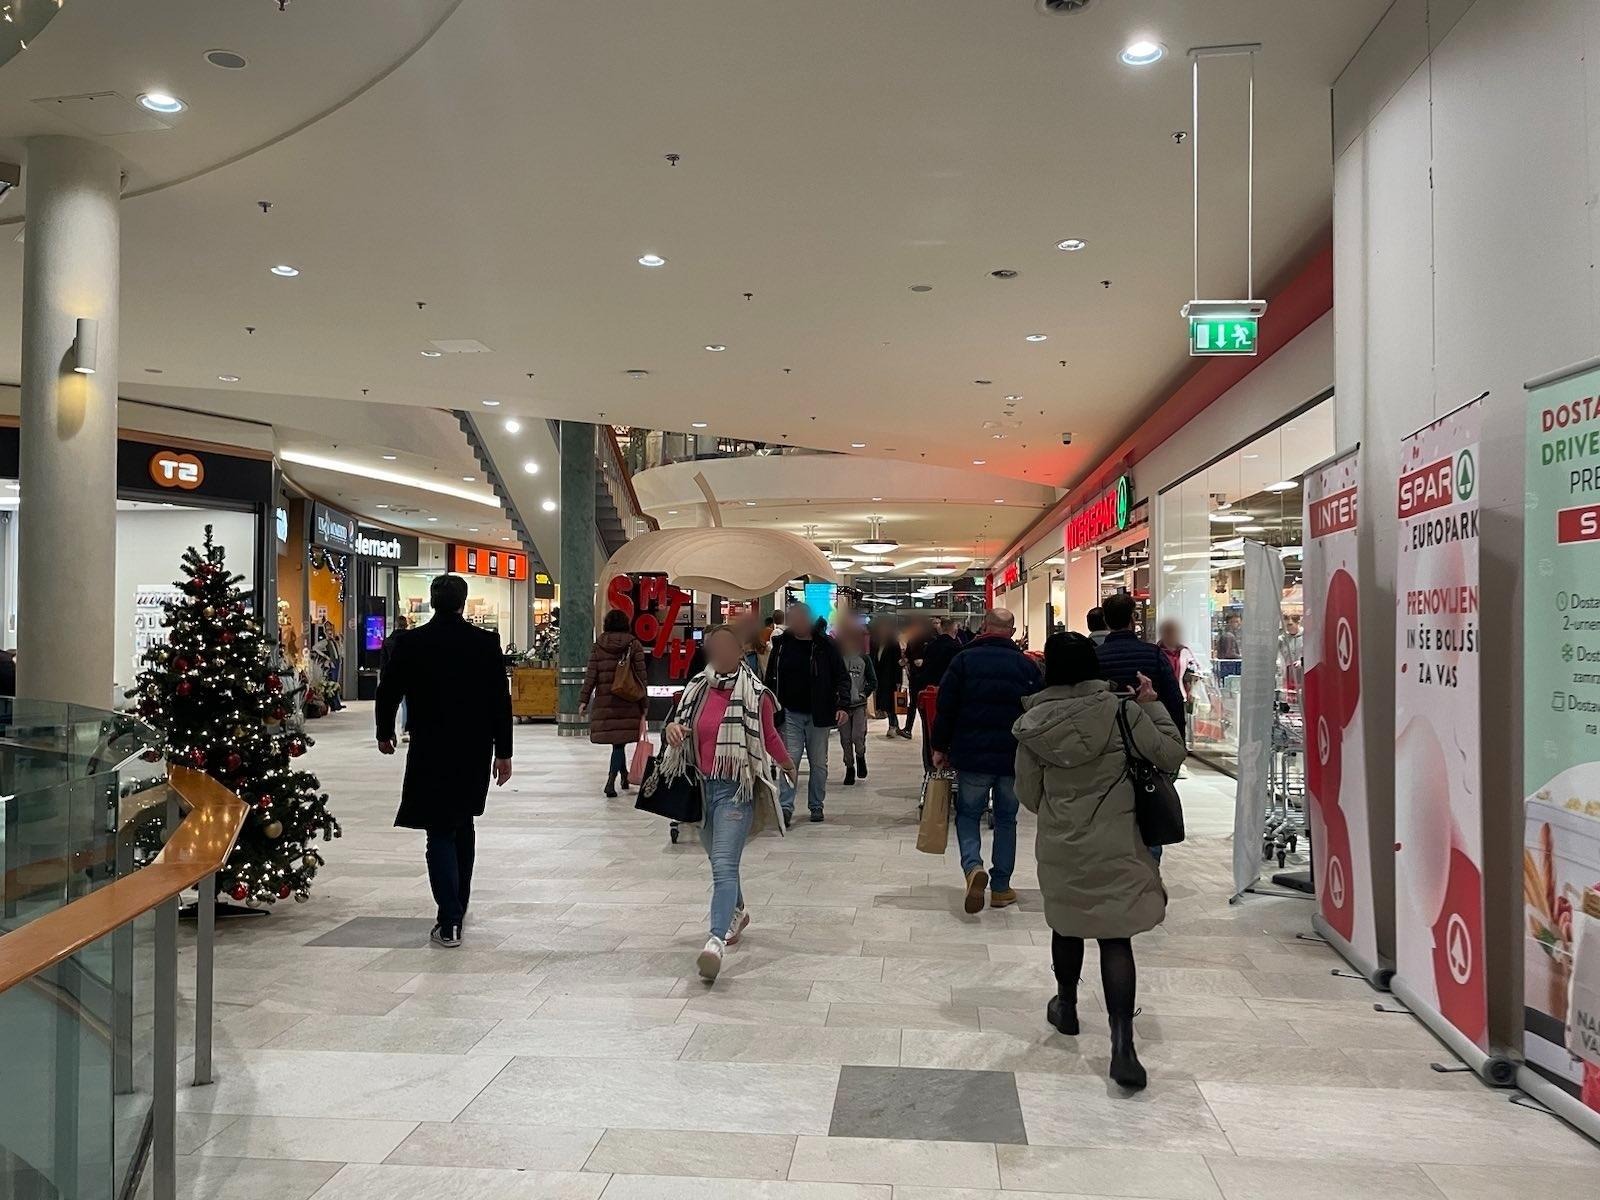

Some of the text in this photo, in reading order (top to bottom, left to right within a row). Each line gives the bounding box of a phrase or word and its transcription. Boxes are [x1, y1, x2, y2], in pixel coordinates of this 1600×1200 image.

[158, 459, 198, 482] T2
[1400, 465, 1452, 511] SPAR
[1412, 508, 1480, 550] EUROPARK
[1407, 585, 1479, 615] PRENOVLJEN
[1419, 623, 1431, 650] ŠE
[1419, 662, 1458, 688] ZA VAS
